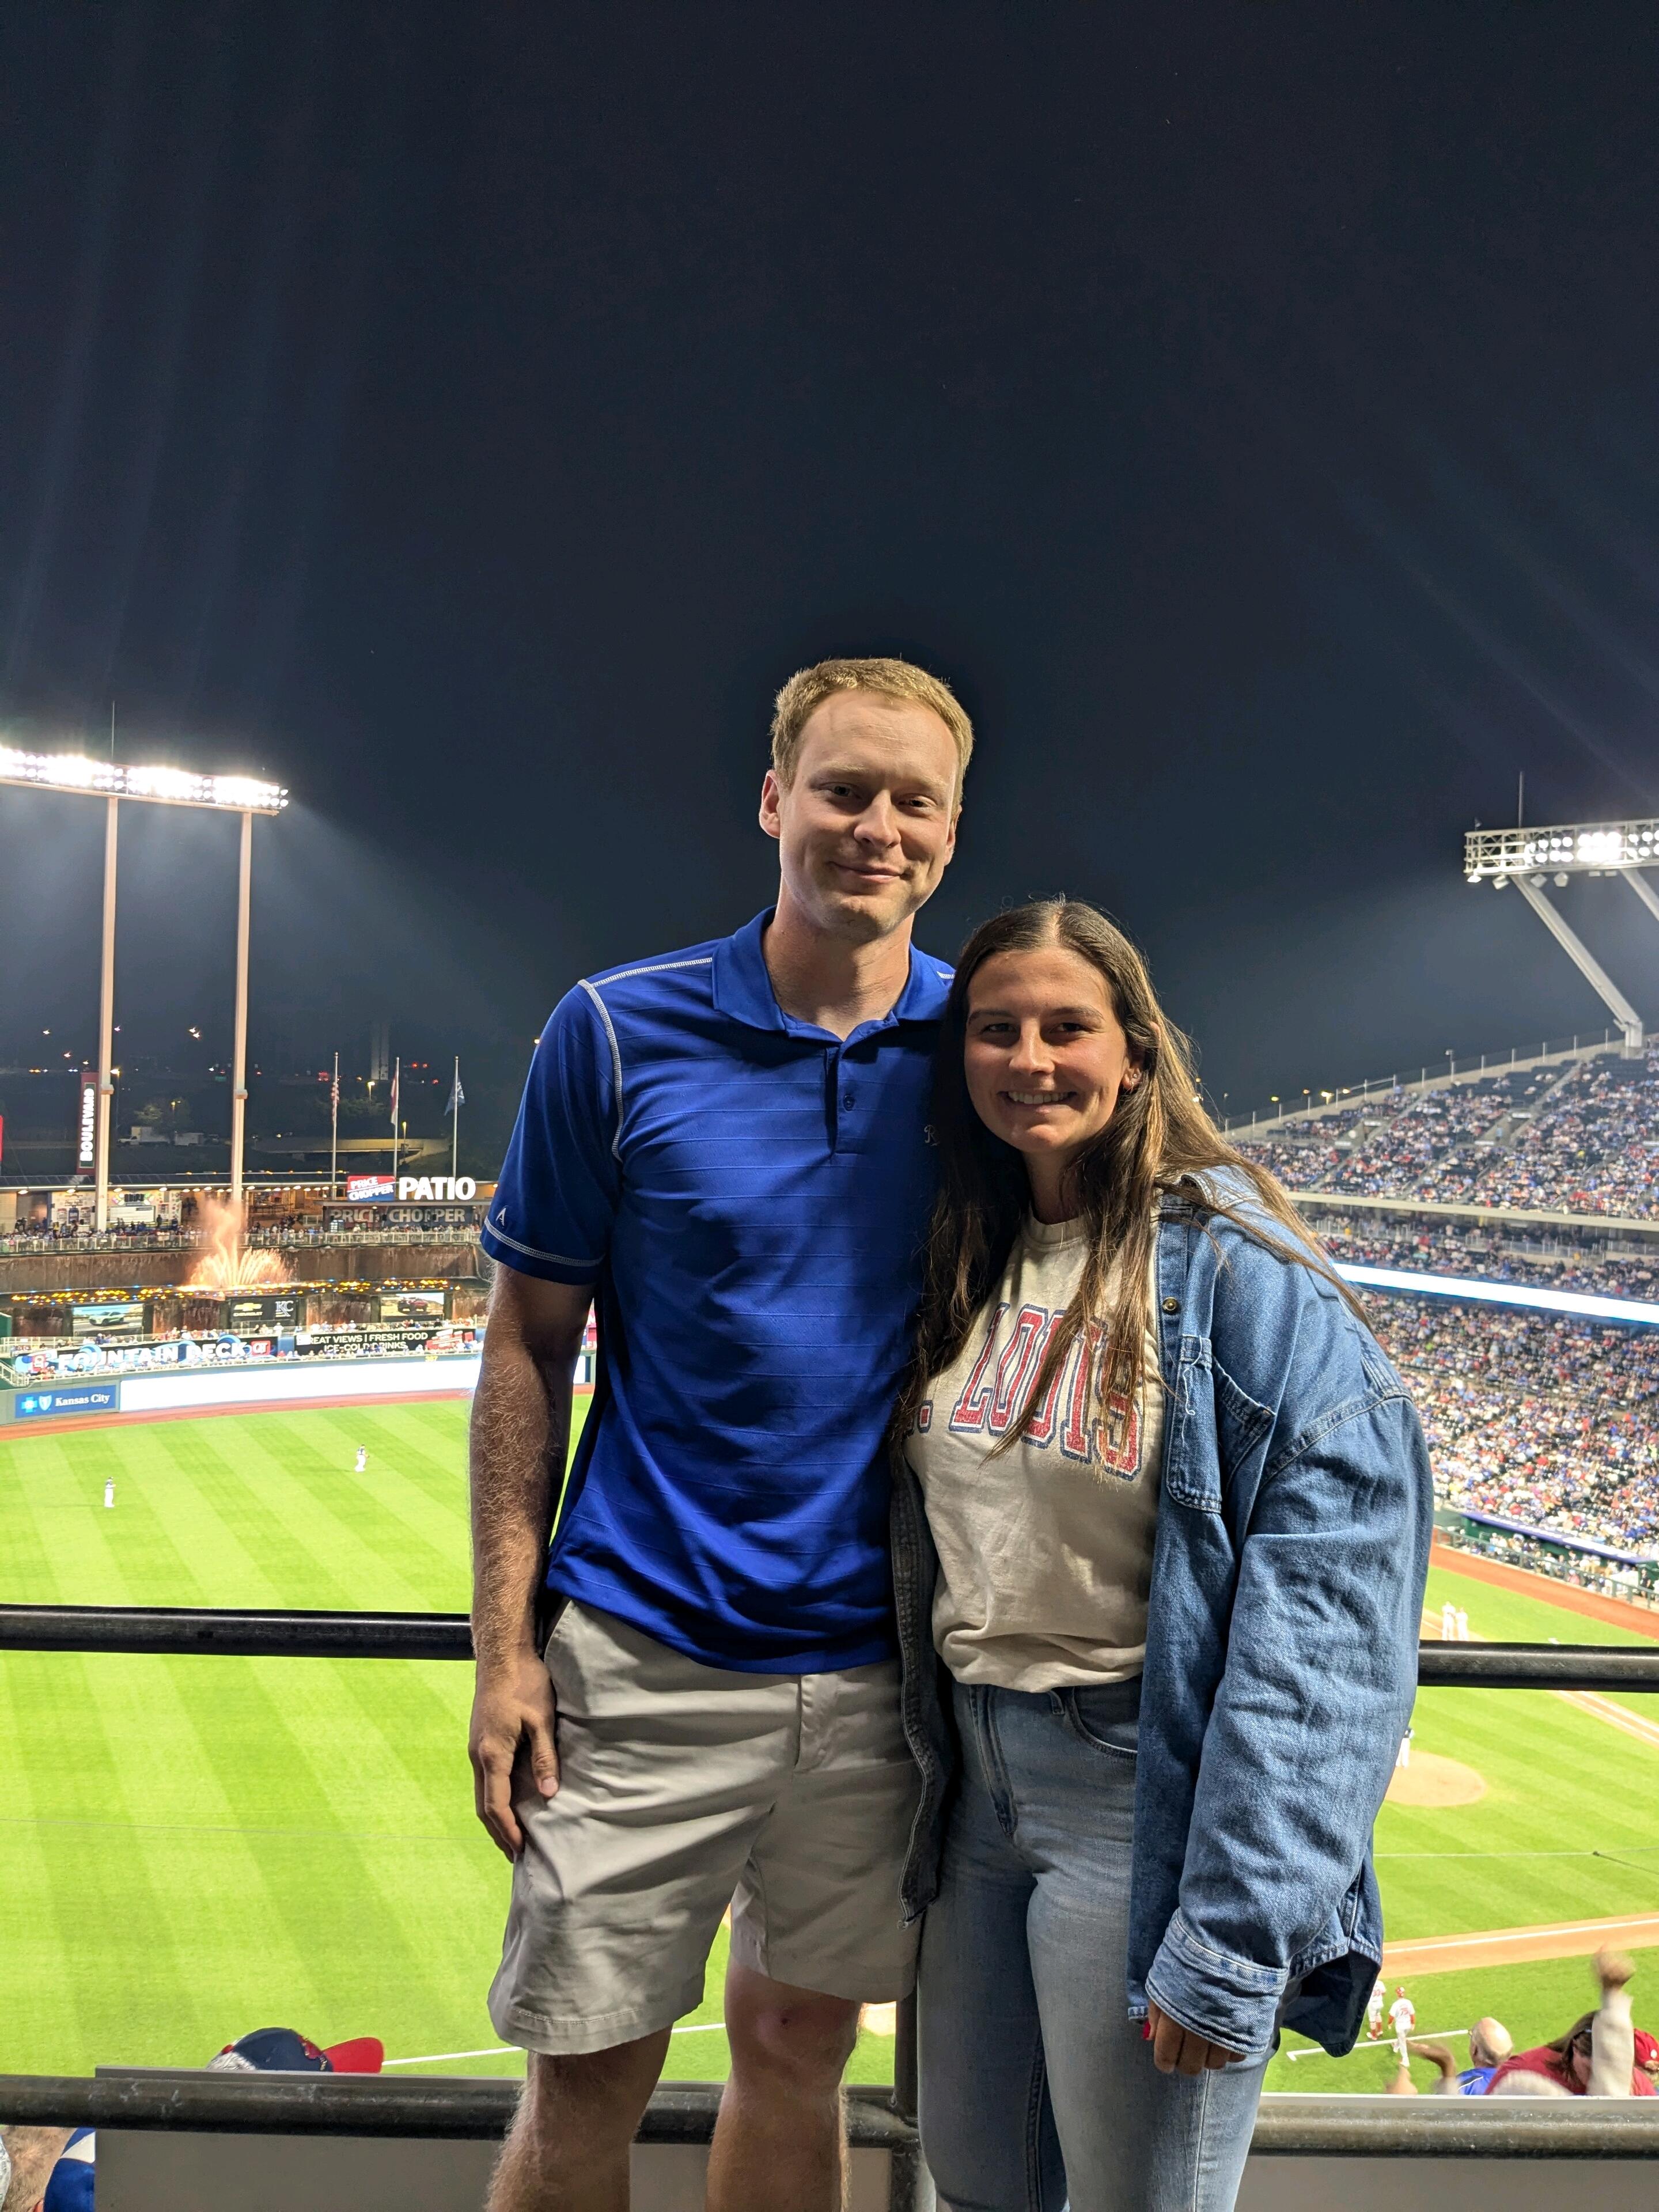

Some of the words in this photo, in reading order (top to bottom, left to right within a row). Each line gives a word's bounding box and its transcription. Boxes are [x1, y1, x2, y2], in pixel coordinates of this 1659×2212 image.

[79, 1088, 94, 1161] BOULEVARD
[350, 1176, 378, 1190] PRICE
[399, 1177, 476, 1200] PATIO
[349, 1184, 393, 1200] CHOPPER
[333, 1334, 362, 1343] VIEWS
[369, 1333, 400, 1342] FRESH
[402, 1332, 428, 1340] FOOD
[58, 1345, 179, 1373] FOUNTAIN
[185, 1342, 248, 1361] DECK
[55, 1396, 89, 1407] Kansas
[90, 1394, 111, 1404] City
